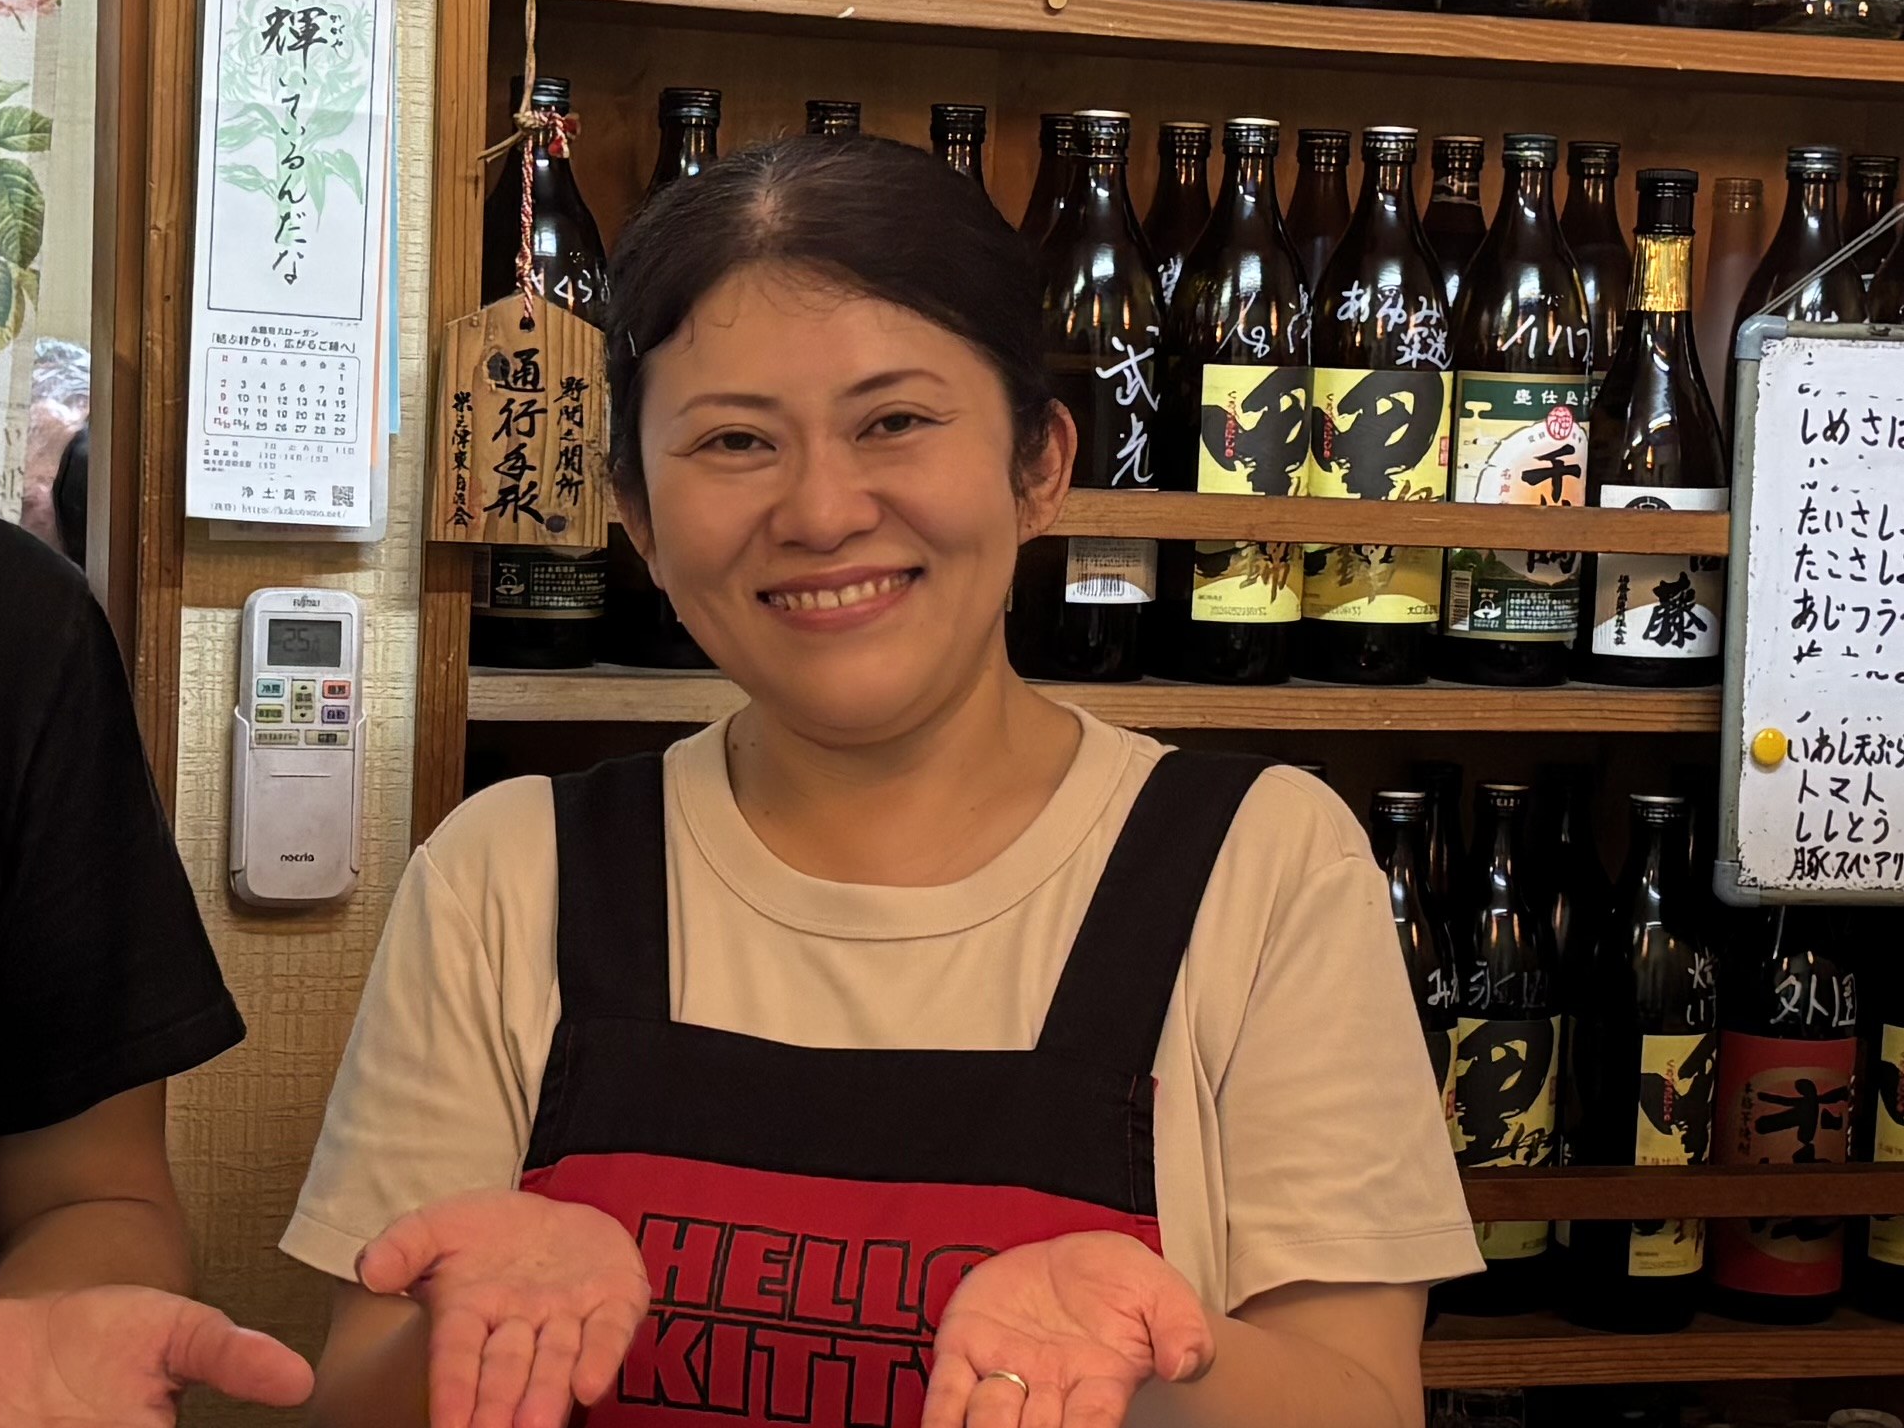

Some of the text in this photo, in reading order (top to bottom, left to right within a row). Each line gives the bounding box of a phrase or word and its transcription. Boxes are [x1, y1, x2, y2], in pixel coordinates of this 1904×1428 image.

[483, 348, 546, 525] 通行手形
[1797, 774, 1885, 807] トマト
[1795, 811, 1890, 845] ししとう
